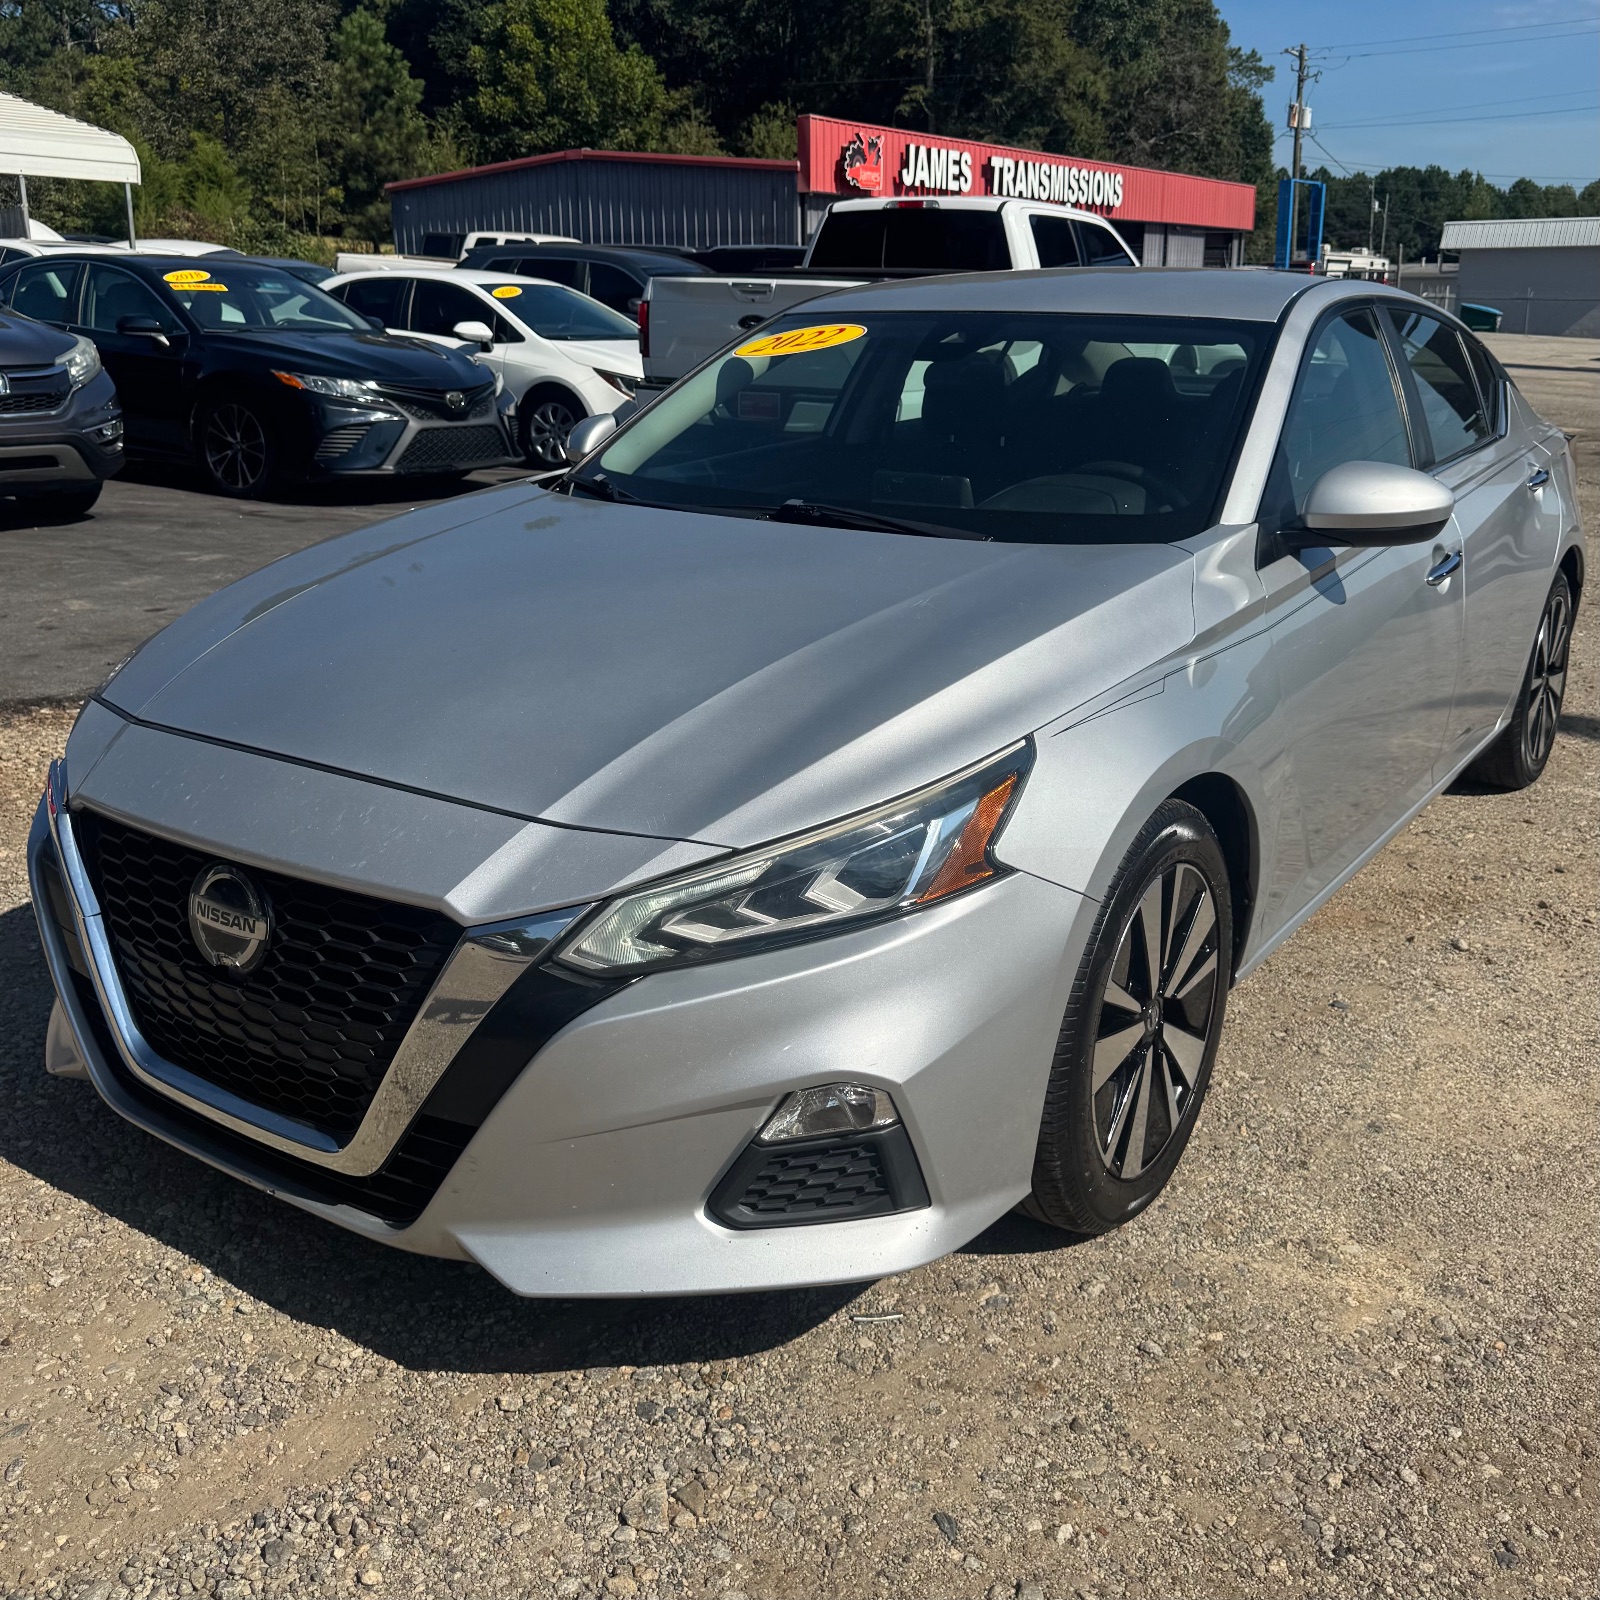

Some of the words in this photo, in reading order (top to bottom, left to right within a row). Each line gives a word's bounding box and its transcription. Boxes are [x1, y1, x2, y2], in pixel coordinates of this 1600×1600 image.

[902, 143, 972, 193] JAMES
[991, 156, 1123, 208] TRANSMISSIONS
[747, 327, 847, 354] 2022
[196, 900, 256, 934] NISSAN
